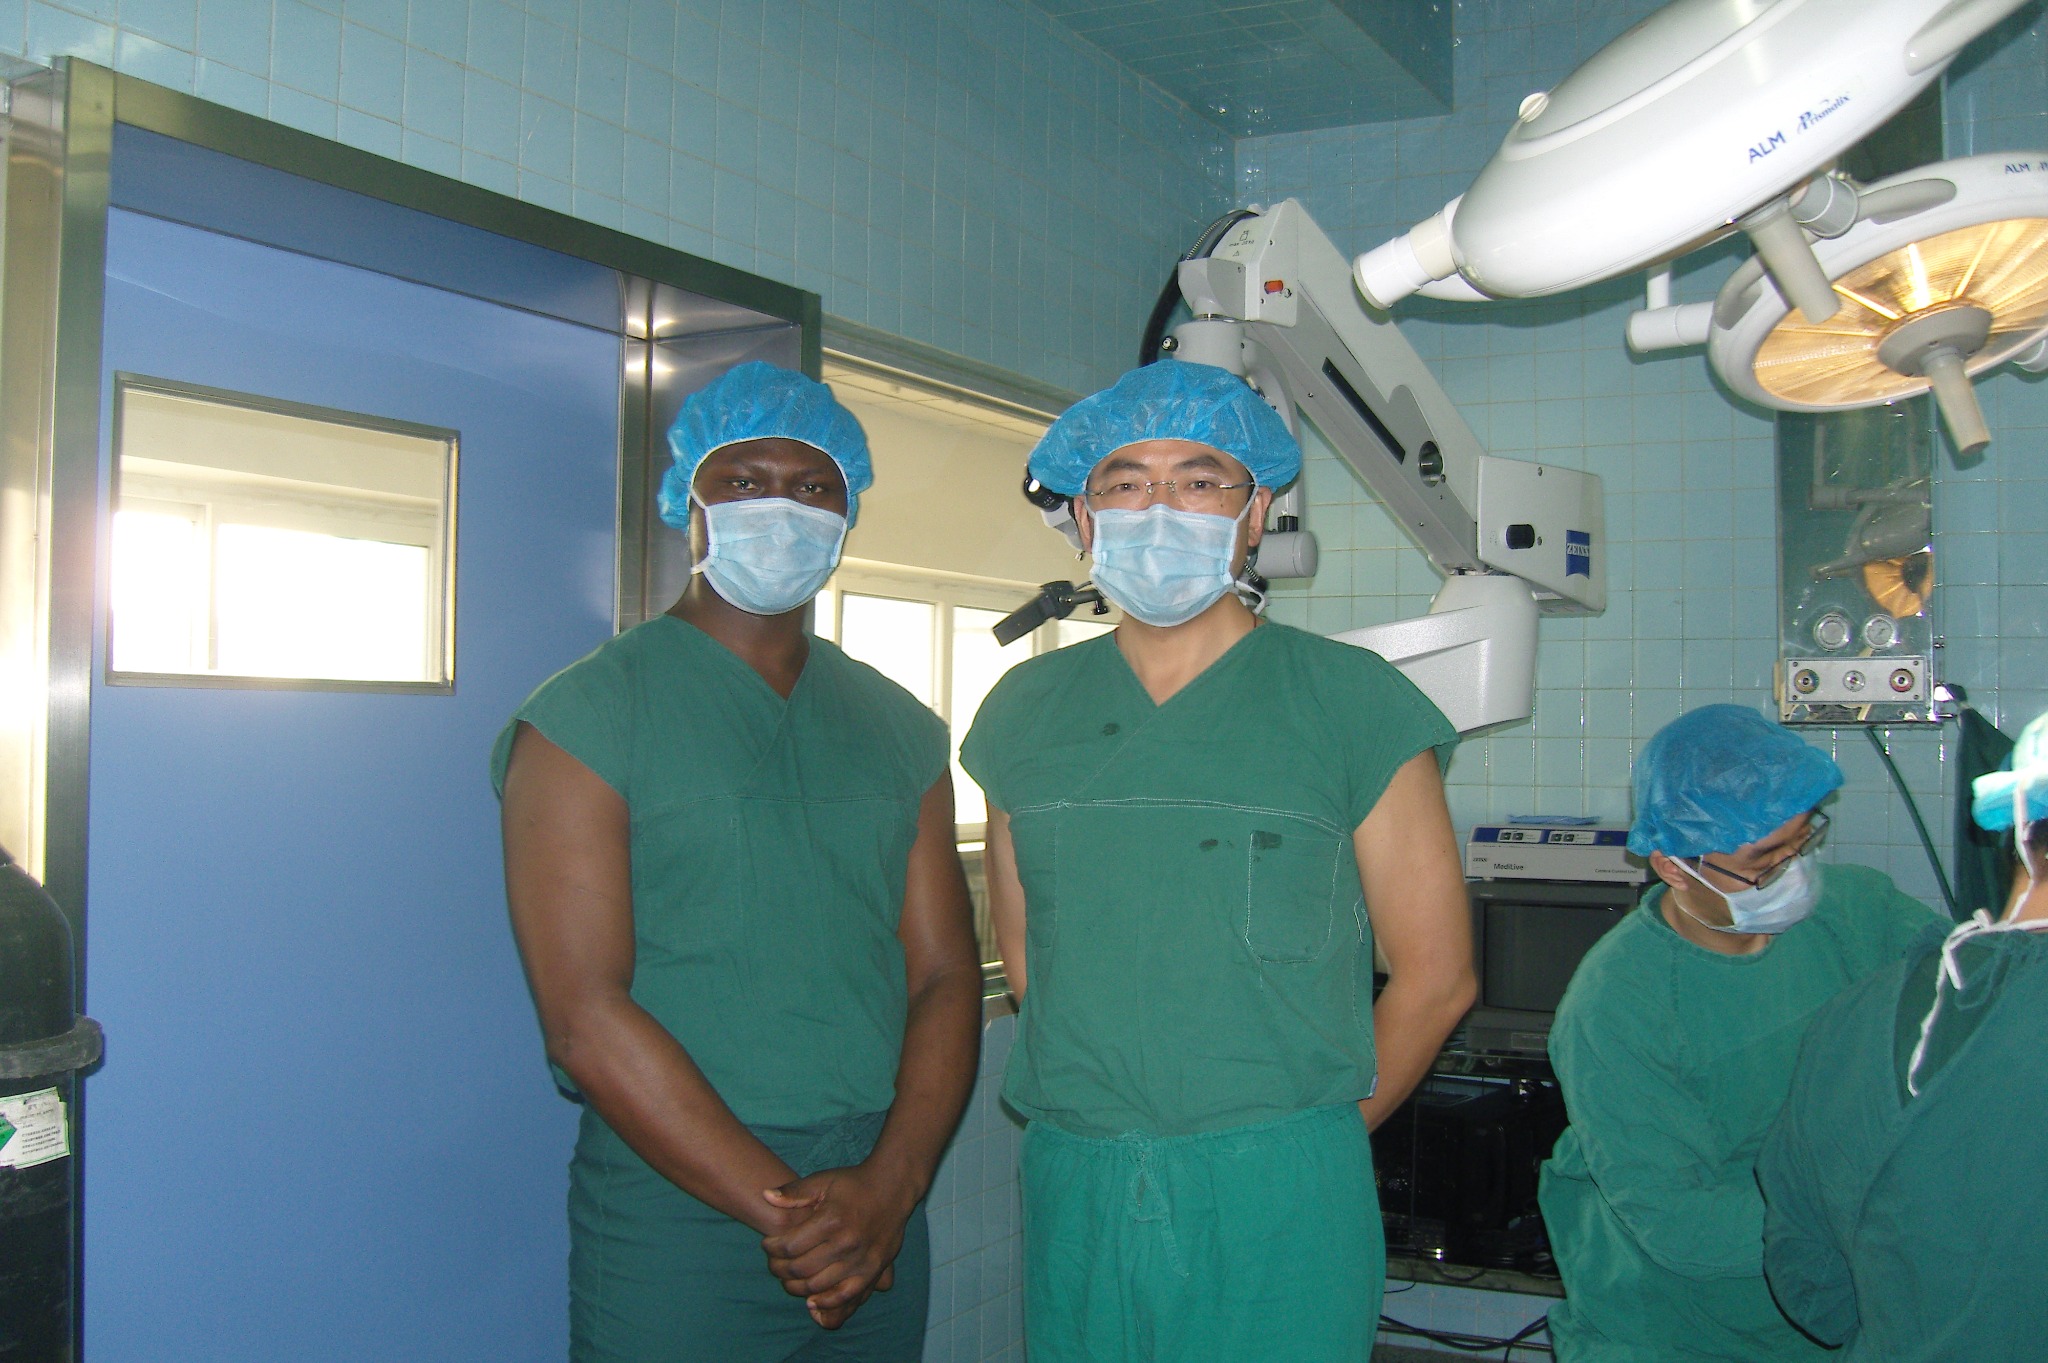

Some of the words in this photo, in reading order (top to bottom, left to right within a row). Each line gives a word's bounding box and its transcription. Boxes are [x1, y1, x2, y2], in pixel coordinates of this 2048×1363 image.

[1748, 130, 1787, 164] ALM
[2004, 162, 2031, 174] ALM
[1567, 542, 1589, 557] ZEISS
[1493, 863, 1524, 871] MediLive
